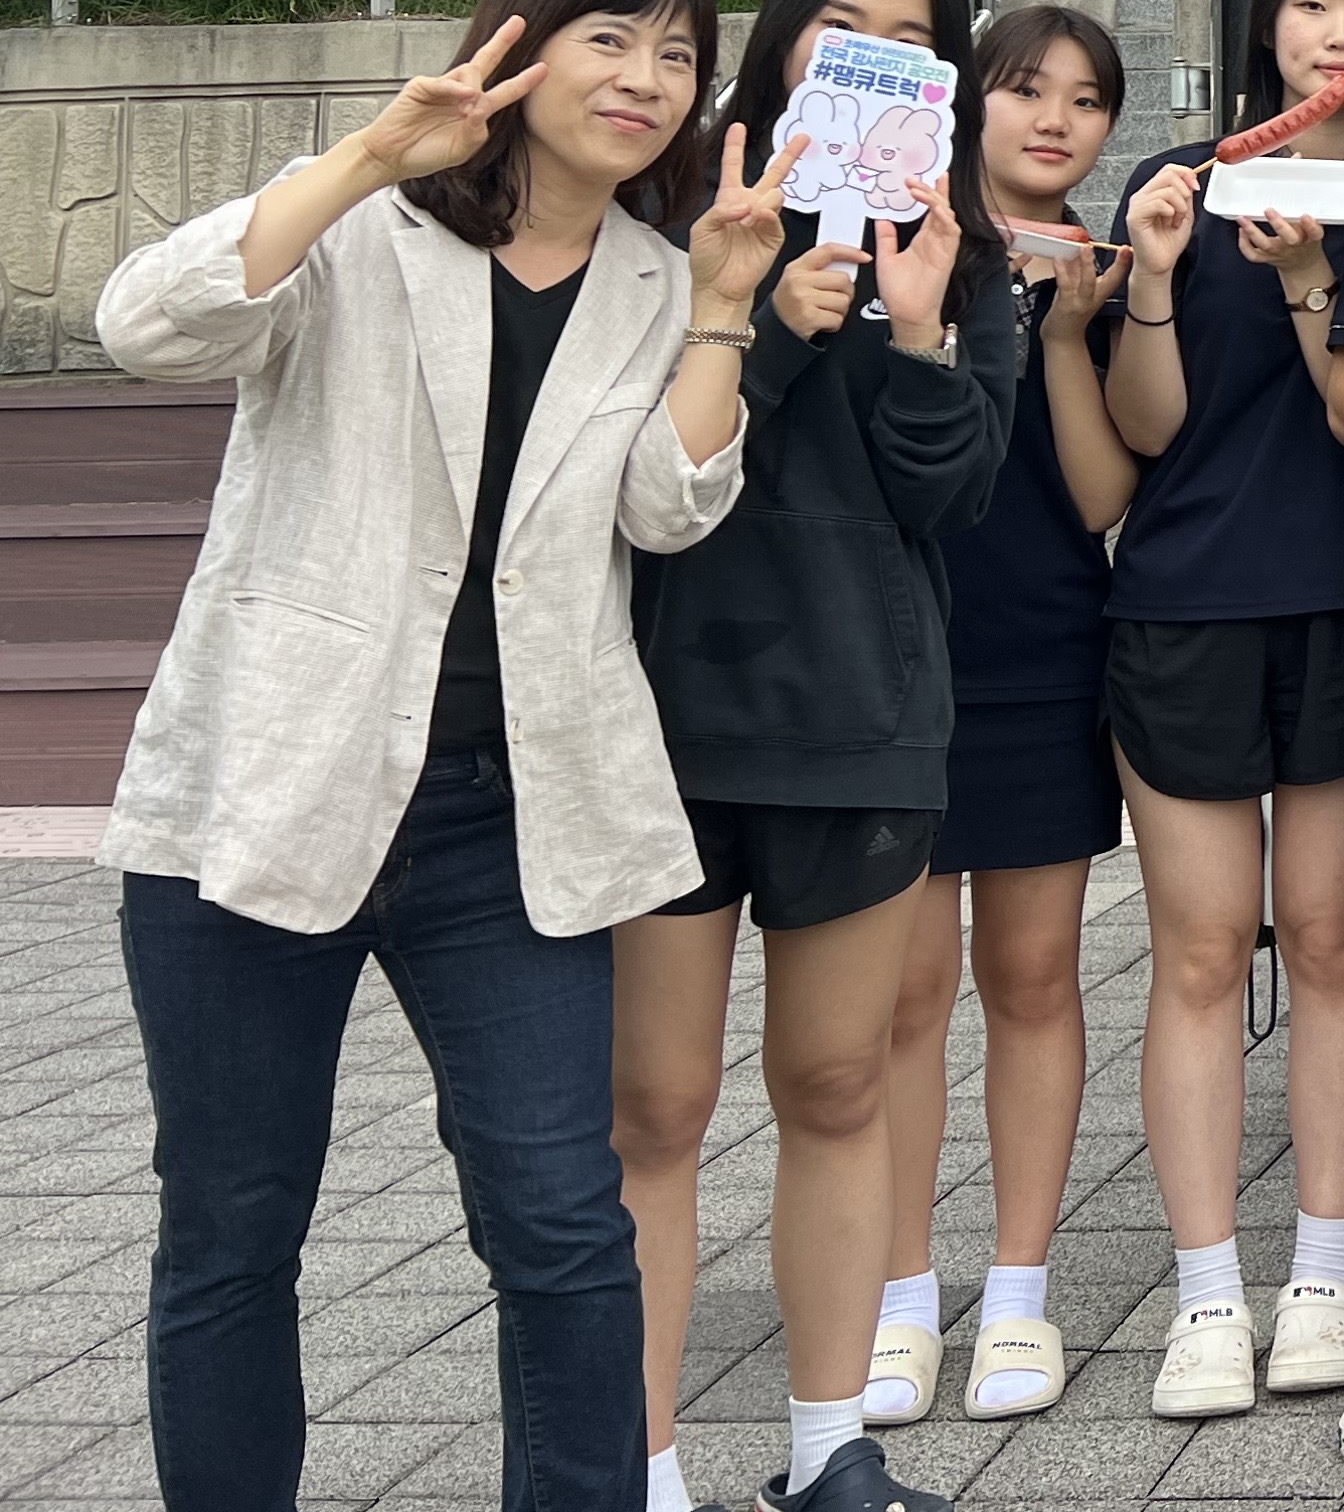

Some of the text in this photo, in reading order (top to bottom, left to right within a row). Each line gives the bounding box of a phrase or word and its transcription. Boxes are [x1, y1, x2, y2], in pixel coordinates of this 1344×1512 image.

[820, 44, 950, 84] 전국 감사편지 공모전
[813, 60, 921, 102] #땡큐트럭
[1313, 1288, 1336, 1297] MLB
[1208, 1308, 1233, 1318] MLB
[991, 1341, 1042, 1350] NORMAL
